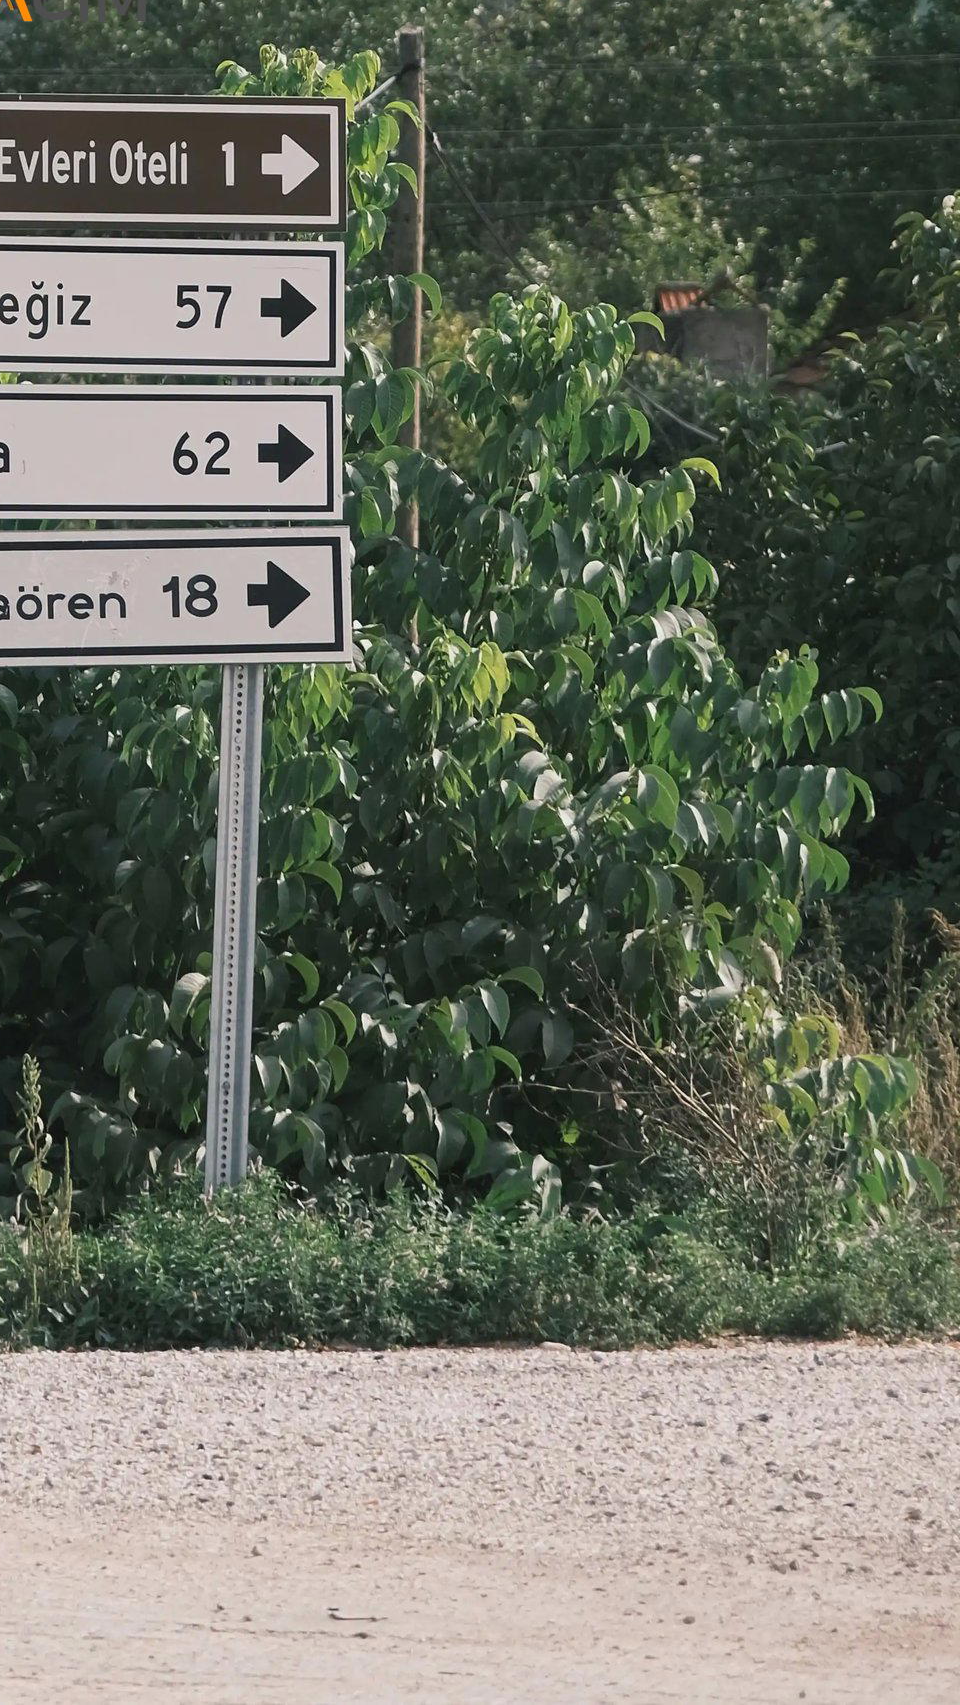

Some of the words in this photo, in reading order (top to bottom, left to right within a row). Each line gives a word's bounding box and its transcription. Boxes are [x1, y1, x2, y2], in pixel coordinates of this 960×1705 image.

[109, 140, 187, 185] Oteli
[221, 141, 235, 186] 1
[175, 284, 232, 329] 57
[172, 430, 230, 475] 62
[162, 573, 218, 617] 18
